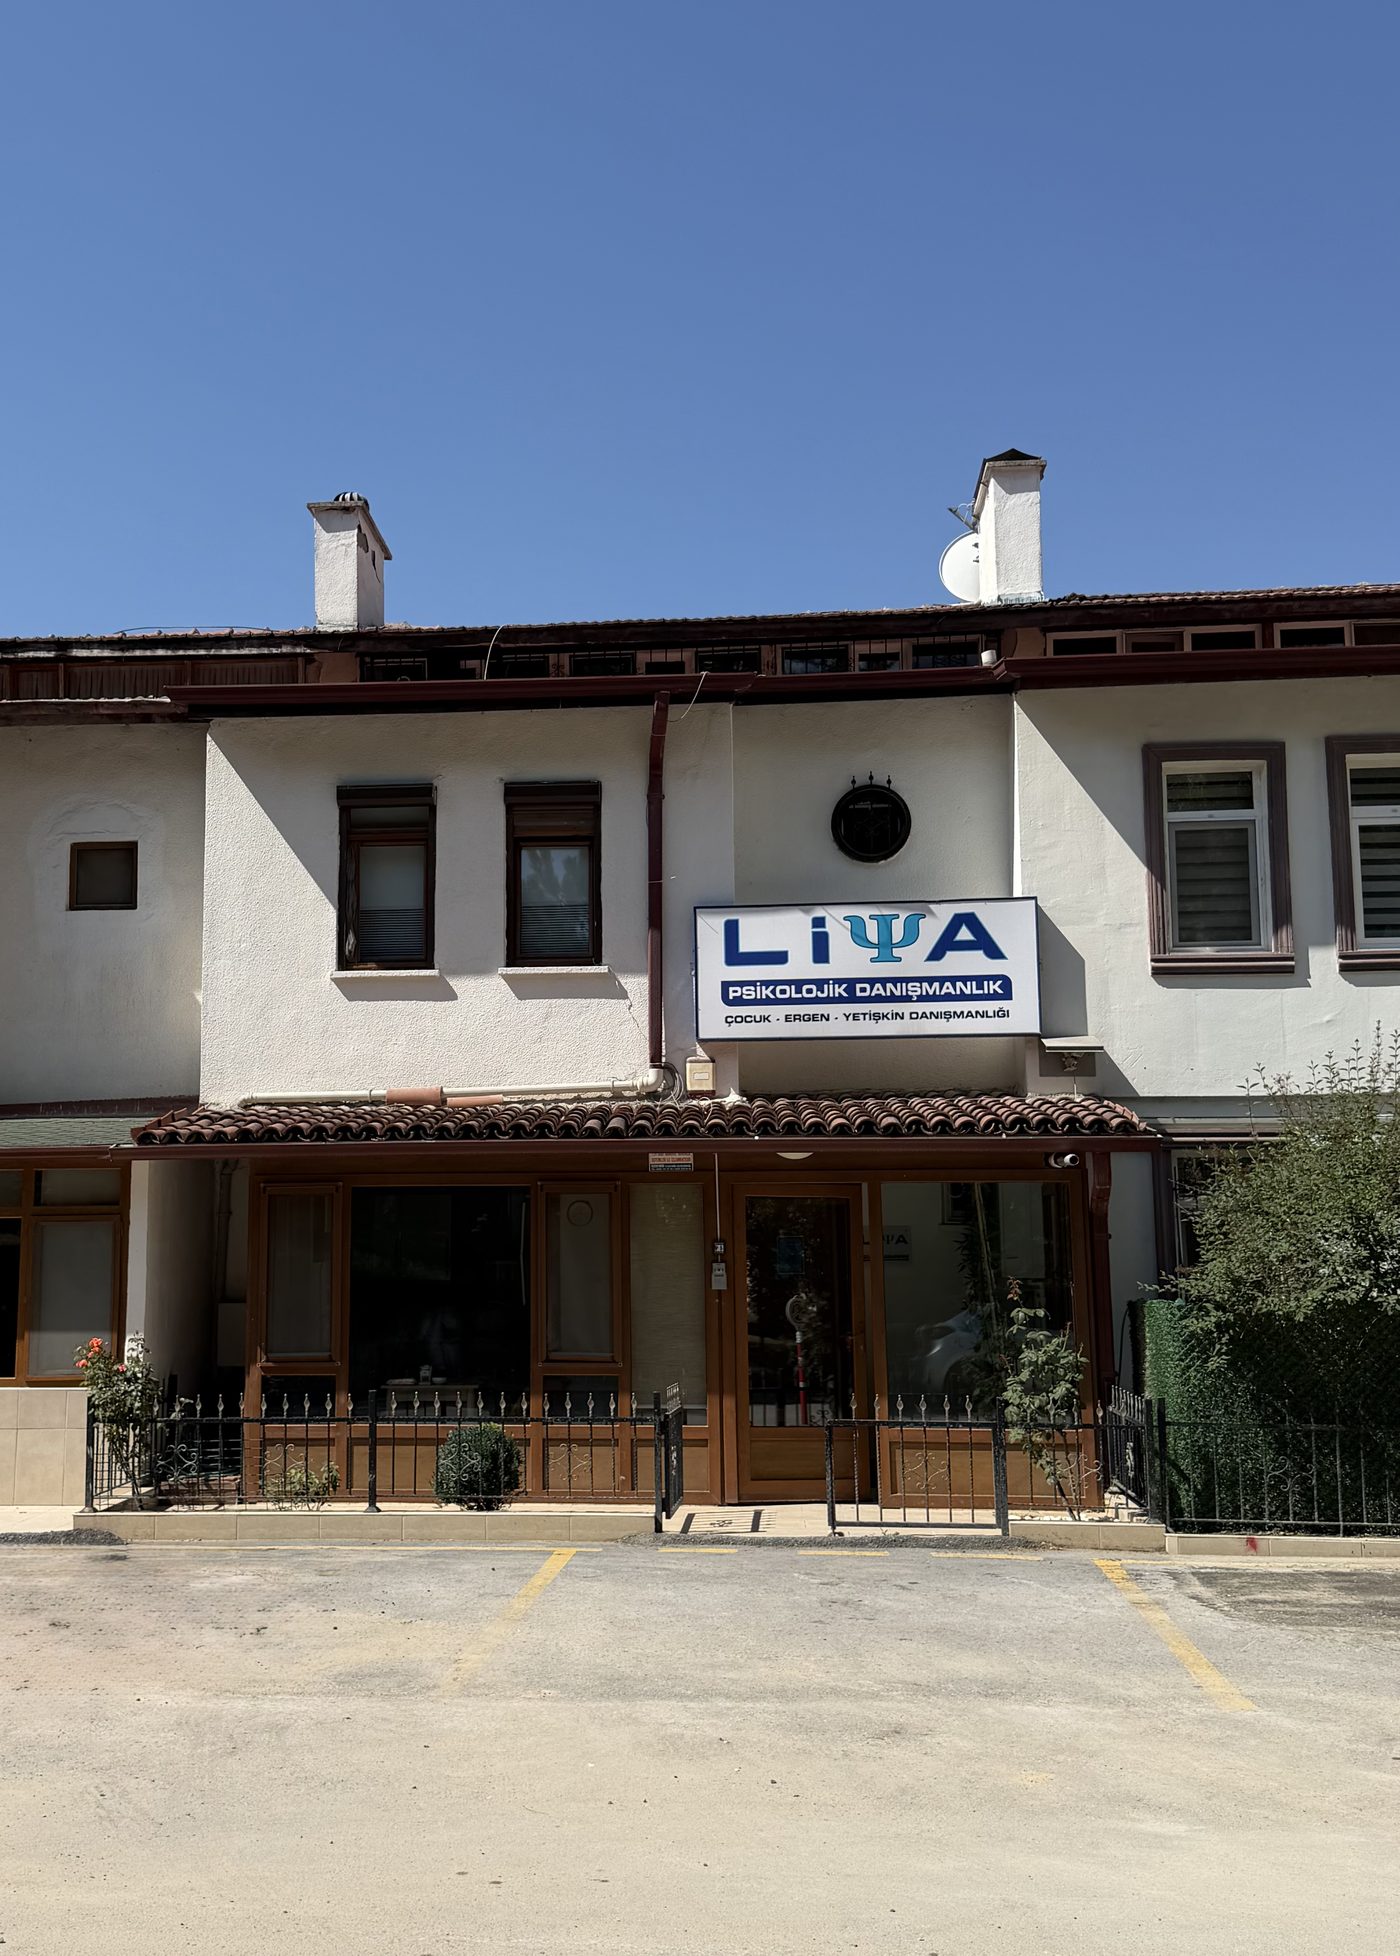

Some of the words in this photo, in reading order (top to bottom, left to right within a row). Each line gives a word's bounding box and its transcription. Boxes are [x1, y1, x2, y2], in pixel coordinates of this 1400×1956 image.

[728, 980, 849, 1000] PSİKOLOJİK
[855, 980, 1004, 1001] DANIŞMANLIK
[724, 1014, 771, 1027] ÇOCUK
[784, 1013, 830, 1022] ERGEN
[843, 1009, 905, 1024] YETİŞKİN
[909, 1007, 1010, 1022] DANIŞMANLIĞI
